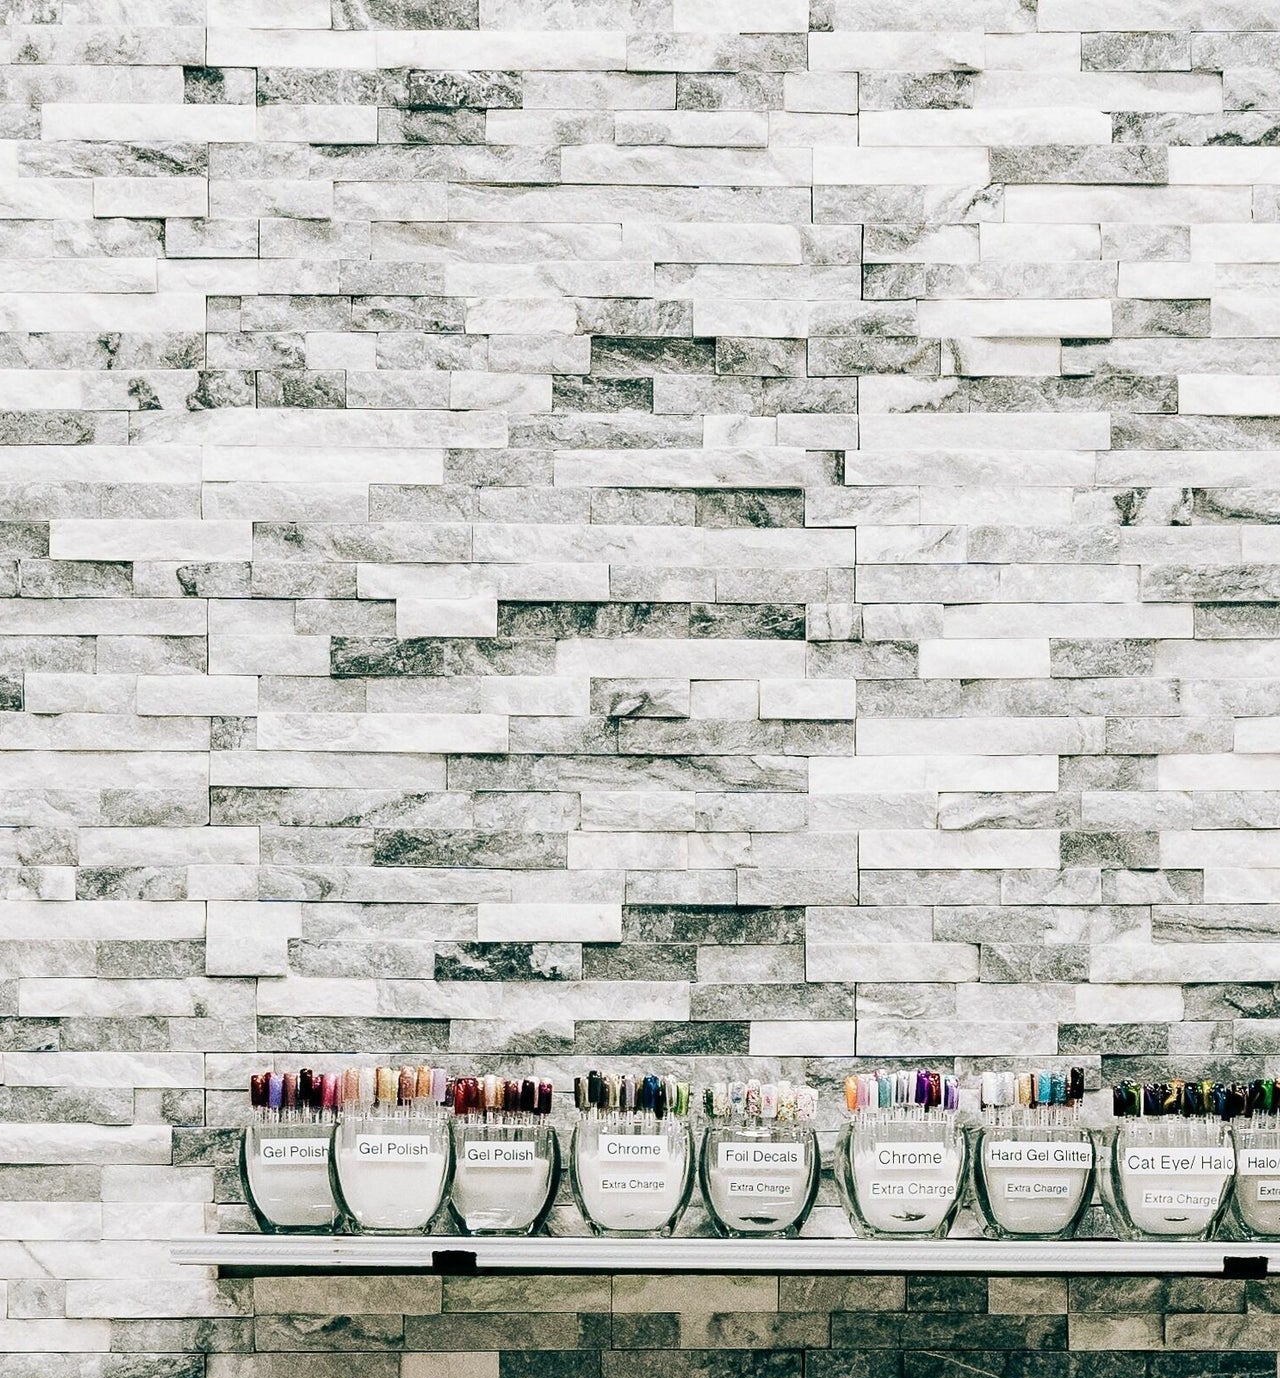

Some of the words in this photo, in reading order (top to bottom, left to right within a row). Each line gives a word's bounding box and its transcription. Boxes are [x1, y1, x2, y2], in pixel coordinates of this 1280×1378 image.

[262, 1144, 287, 1160] Gel
[289, 1143, 329, 1159] Polish
[358, 1141, 384, 1156] Gel
[386, 1140, 429, 1156] Polish
[467, 1147, 491, 1162] Gel
[493, 1147, 534, 1162] Polish
[606, 1140, 662, 1157] Chrome
[725, 1148, 750, 1164] Foil
[752, 1149, 798, 1164] Decals
[990, 1148, 1023, 1163] Hard
[1026, 1147, 1050, 1163] Gel
[1053, 1147, 1091, 1164] Glitter
[877, 1149, 943, 1166] Chrome
[1127, 1153, 1156, 1171] Cat
[1200, 1155, 1235, 1171] Halo
[601, 1179, 627, 1190] Extra
[629, 1179, 665, 1193] Charge
[729, 1182, 755, 1193] Extra
[756, 1182, 792, 1196] Charge
[871, 1183, 905, 1196] Extra
[907, 1183, 955, 1200] Charge
[1006, 1183, 1031, 1194] Extra
[1033, 1183, 1069, 1197] Charge
[1144, 1192, 1174, 1205] Extra
[1177, 1193, 1218, 1207] Charge
